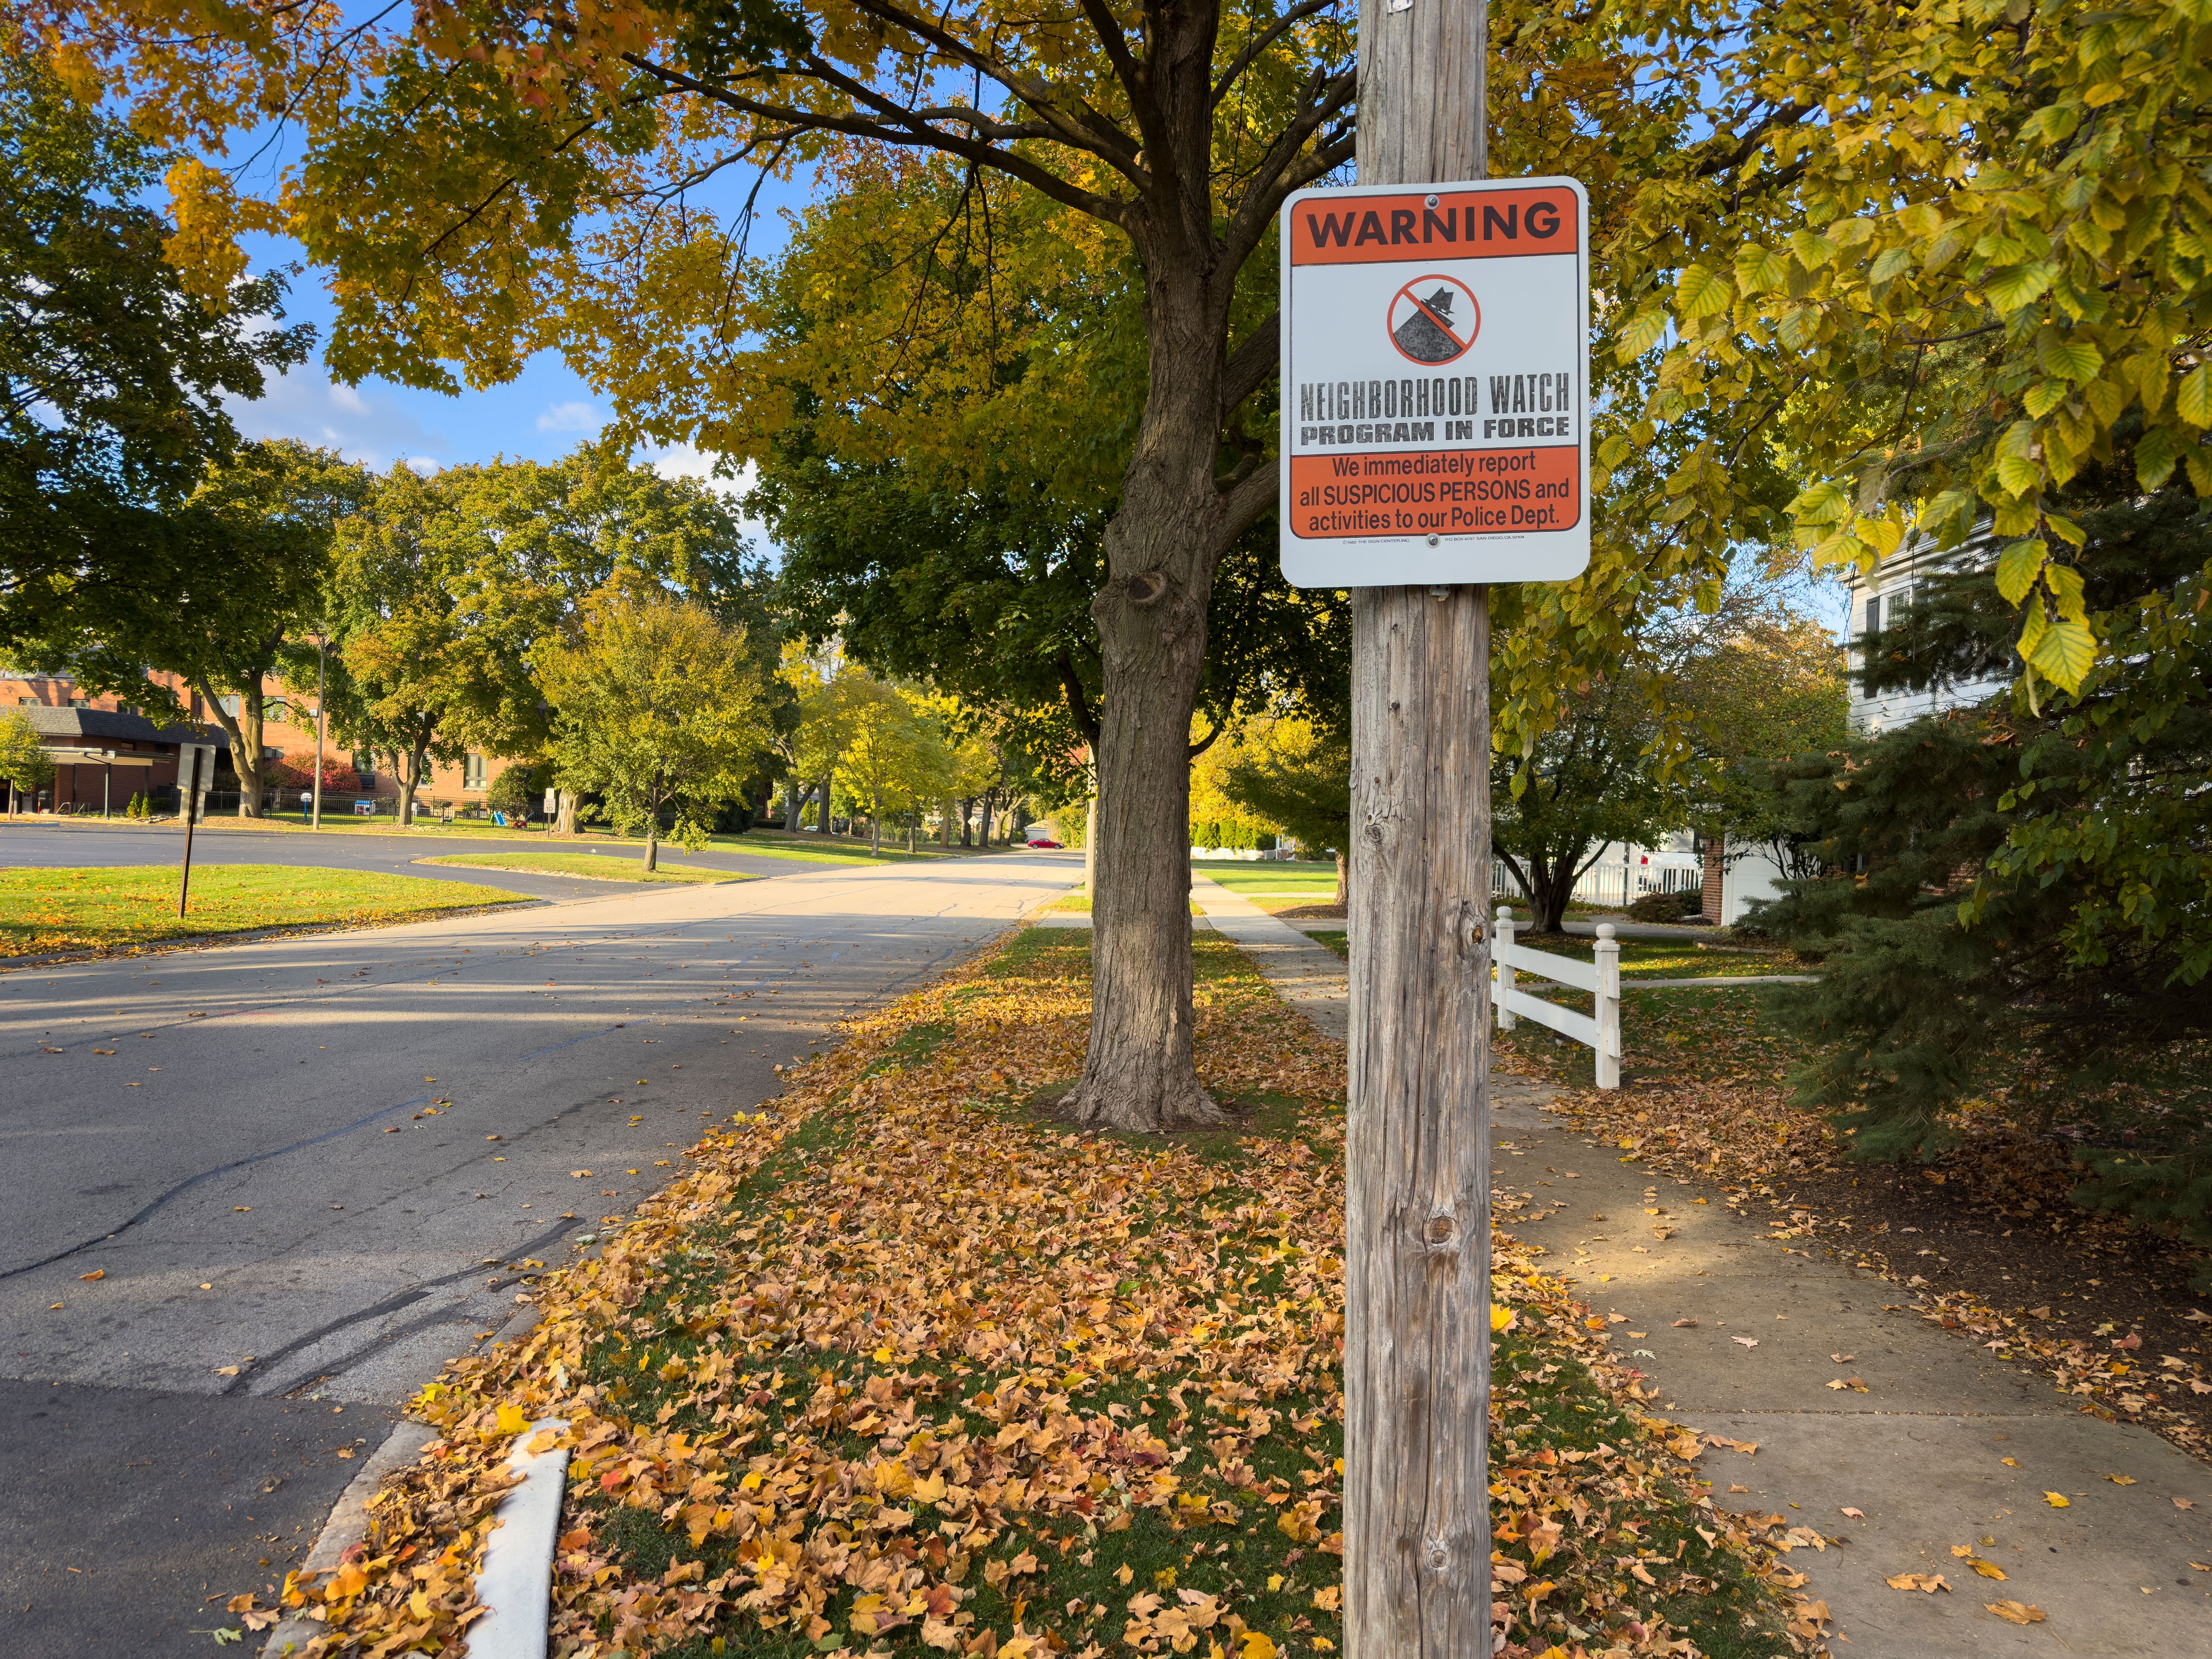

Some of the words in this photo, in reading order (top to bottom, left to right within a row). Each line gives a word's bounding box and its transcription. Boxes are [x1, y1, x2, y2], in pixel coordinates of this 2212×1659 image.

[1306, 202, 1560, 248] WARNING
[1301, 377, 1477, 421] NEIGHBORHOOD
[1490, 373, 1569, 414] WATCH
[1301, 422, 1434, 445] PROGRAM
[1445, 420, 1472, 440] IN
[1484, 417, 1569, 439] FORCE
[1333, 458, 1359, 477] We
[1364, 454, 1475, 477] immediately
[1479, 451, 1536, 477] report
[1300, 487, 1319, 507] all
[1324, 482, 1435, 505] SUSPICIOUS
[1440, 479, 1530, 502] PERSONS
[1536, 478, 1569, 498] and
[1309, 510, 1390, 531] activities
[1396, 509, 1413, 528] to
[1418, 512, 1447, 528] our
[1452, 507, 1506, 527] Police
[1511, 504, 1559, 528] Dept.
